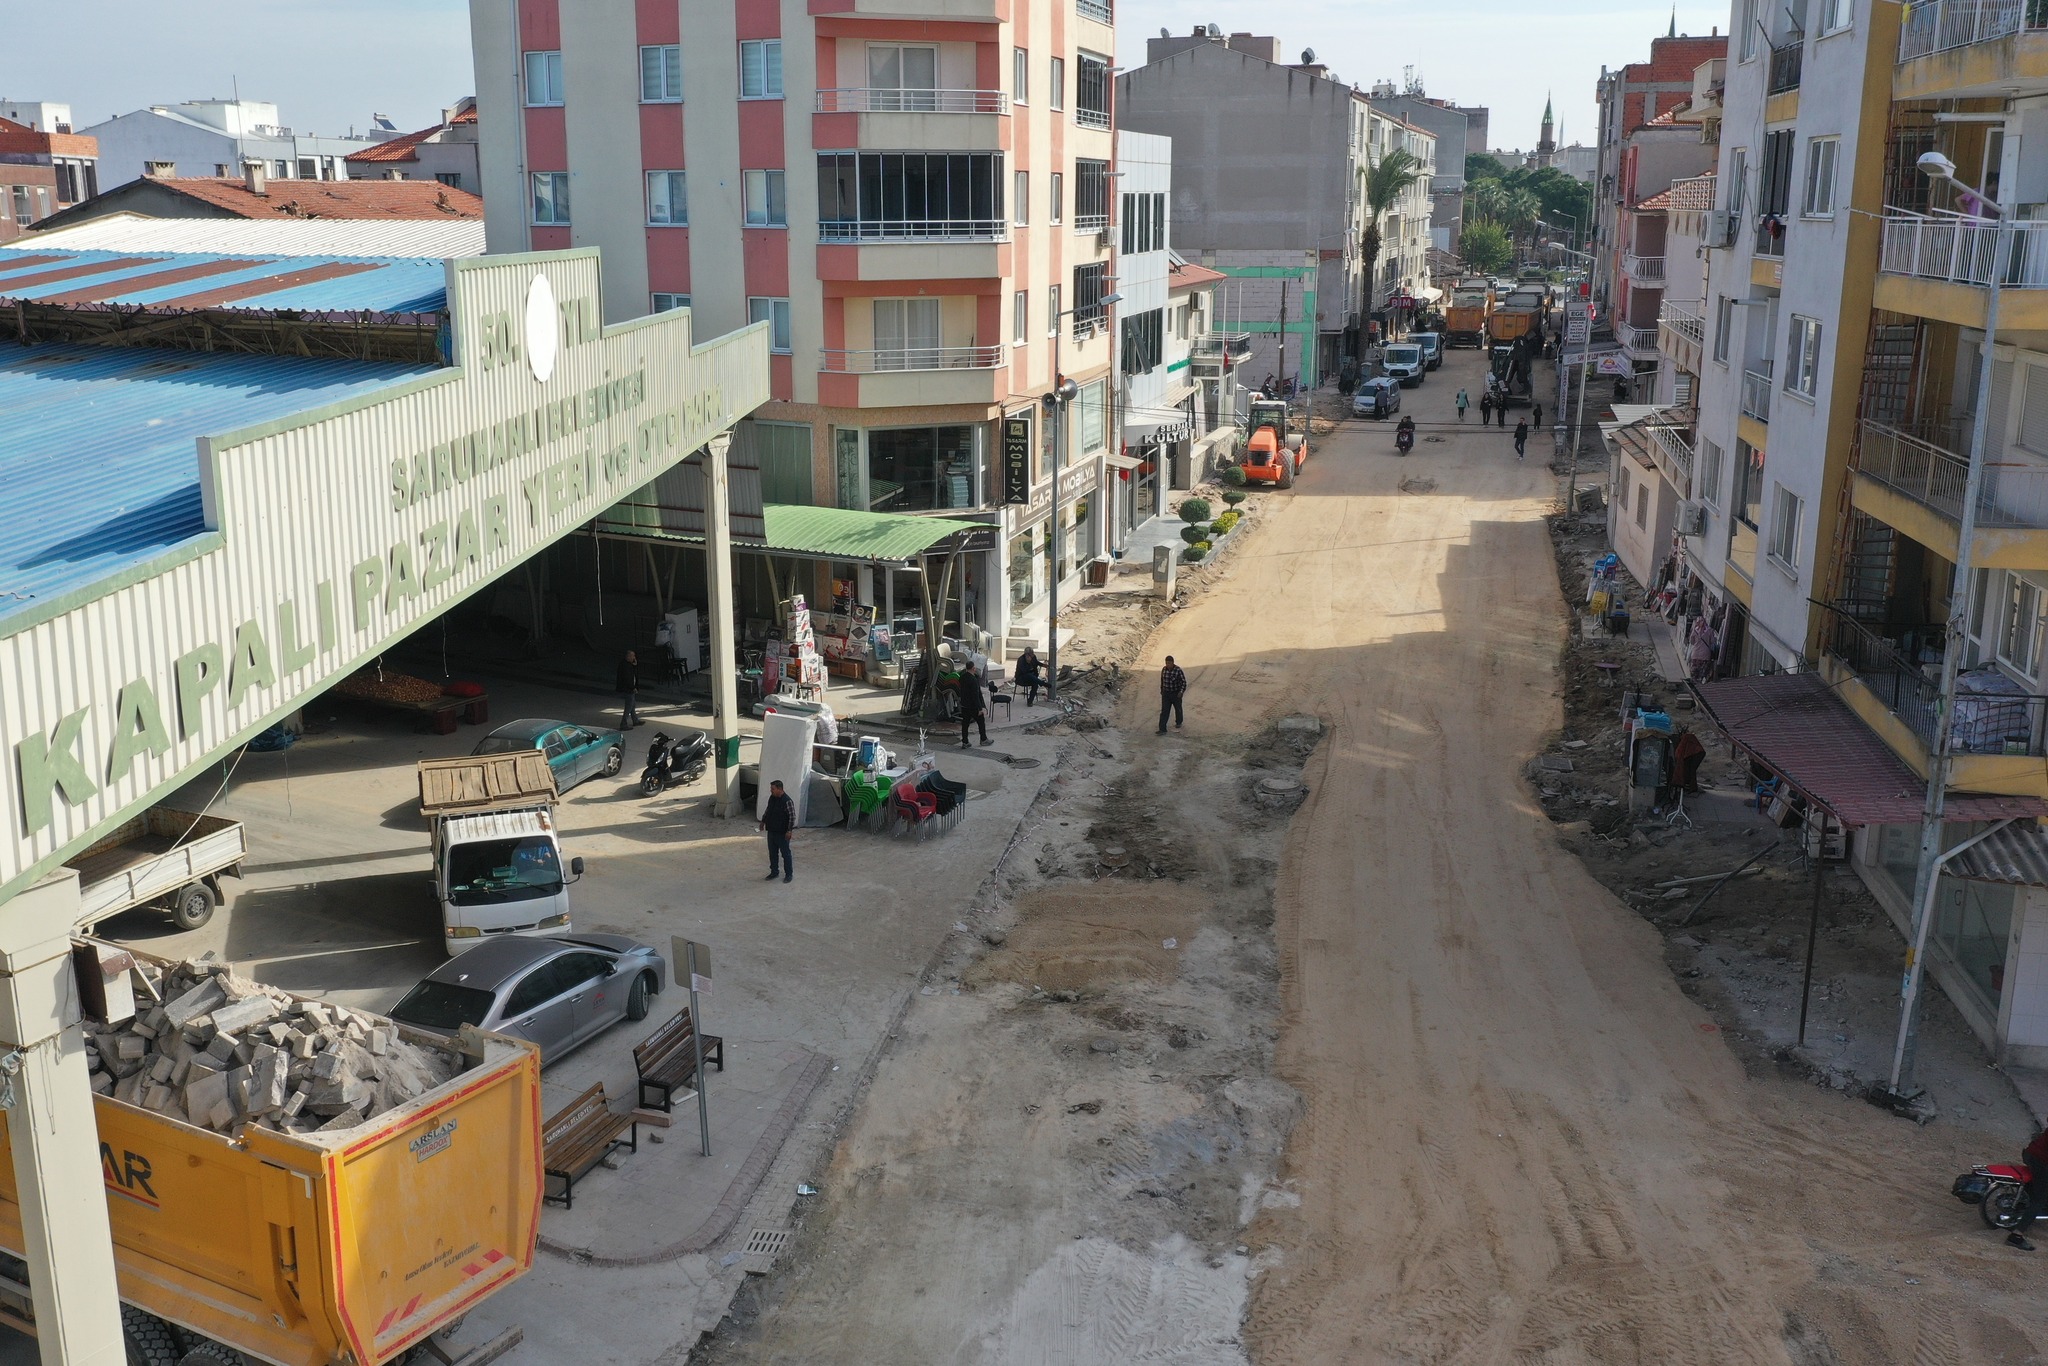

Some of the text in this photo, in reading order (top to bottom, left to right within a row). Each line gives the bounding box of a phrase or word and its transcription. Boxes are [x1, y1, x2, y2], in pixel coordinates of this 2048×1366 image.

[480, 310, 521, 371] 50.
[391, 356, 644, 512] SARUHANLI BELEDİYESİ
[15, 578, 336, 837] KAPALI
[351, 493, 510, 634] PAZAR
[522, 431, 596, 528] YERİ
[601, 442, 631, 484] ve
[411, 1120, 455, 1150] ARSLAN
[419, 1136, 449, 1157] HARDOX
